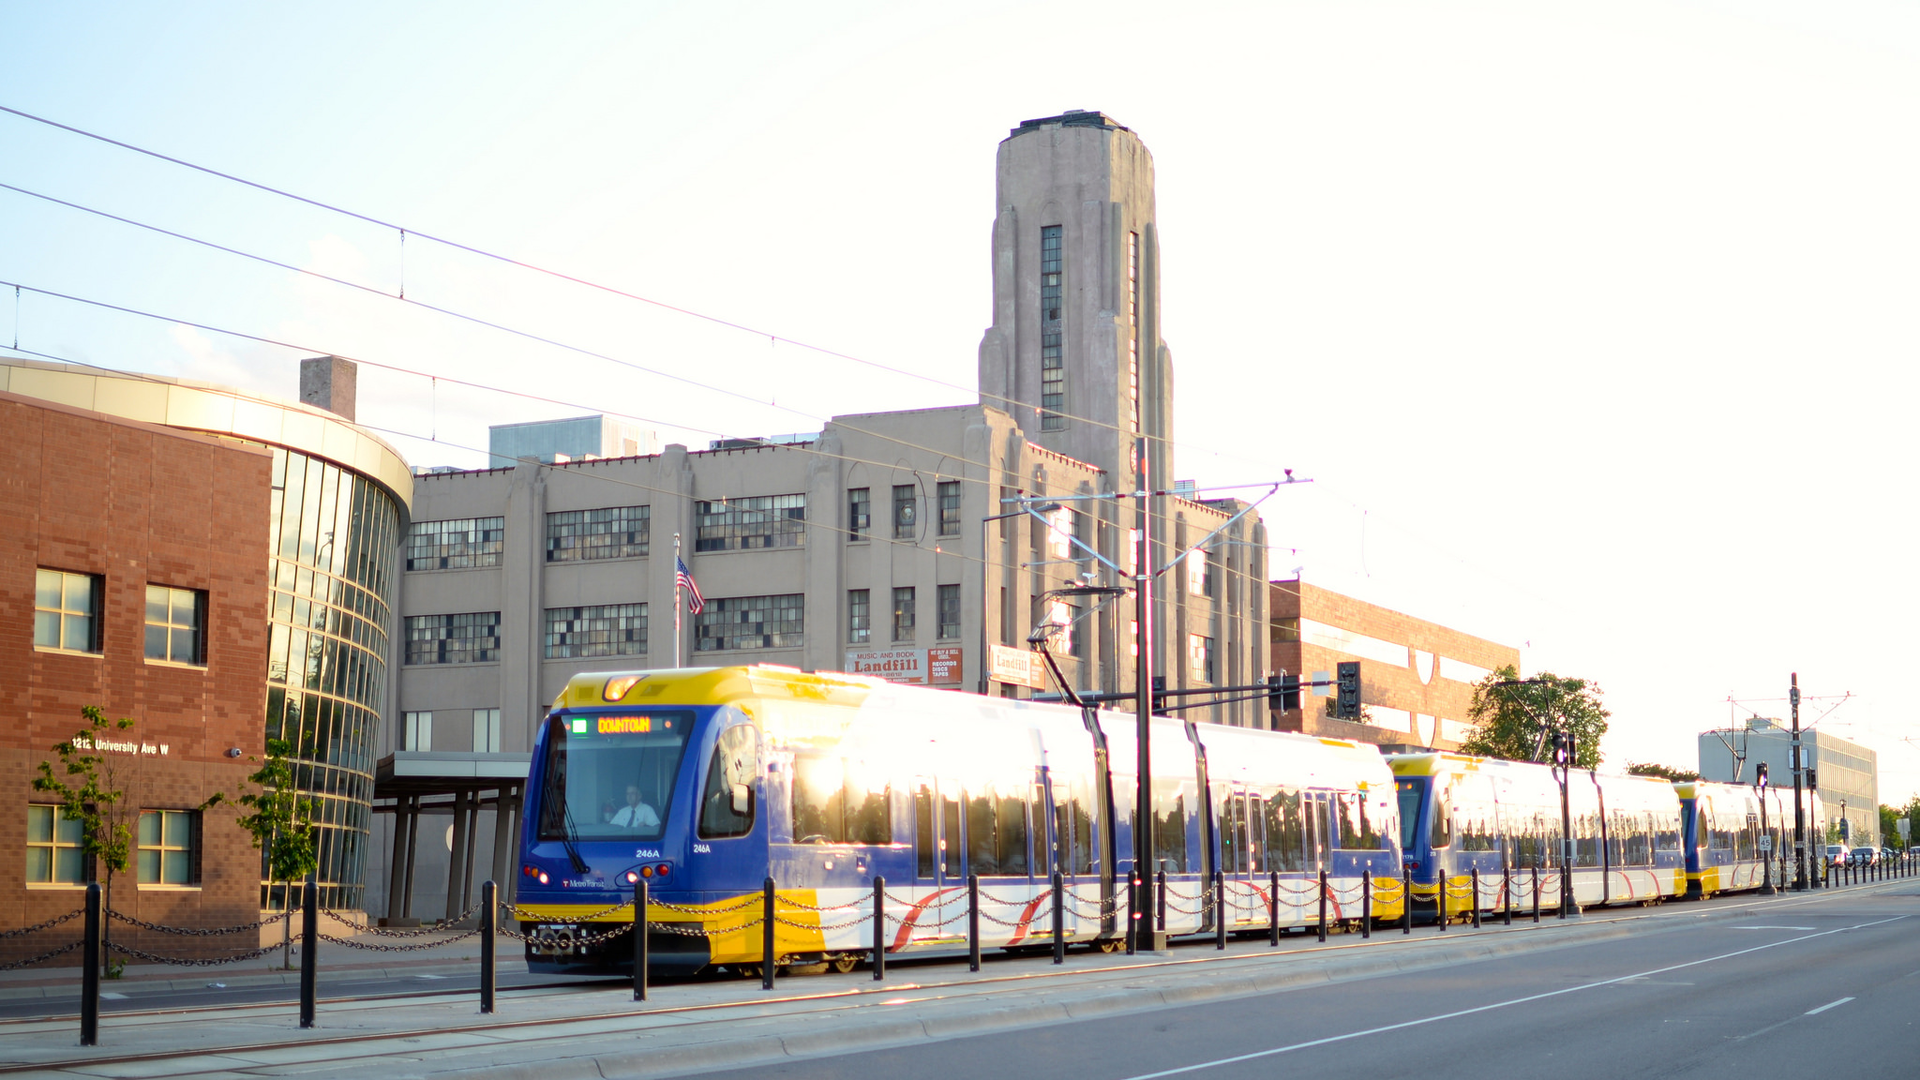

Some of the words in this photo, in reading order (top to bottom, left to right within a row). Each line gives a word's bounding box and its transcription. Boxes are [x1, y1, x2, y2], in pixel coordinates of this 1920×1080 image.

[857, 652, 877, 660] MUSIC
[997, 654, 1028, 672] Landfill
[854, 659, 919, 673] Landfill
[598, 717, 650, 733] DOWNTOWN
[72, 738, 91, 749] 1212
[95, 739, 138, 755] University
[141, 742, 157, 755] Ave
[160, 744, 169, 755] W
[636, 850, 660, 858] 246A
[693, 844, 710, 853] 246A
